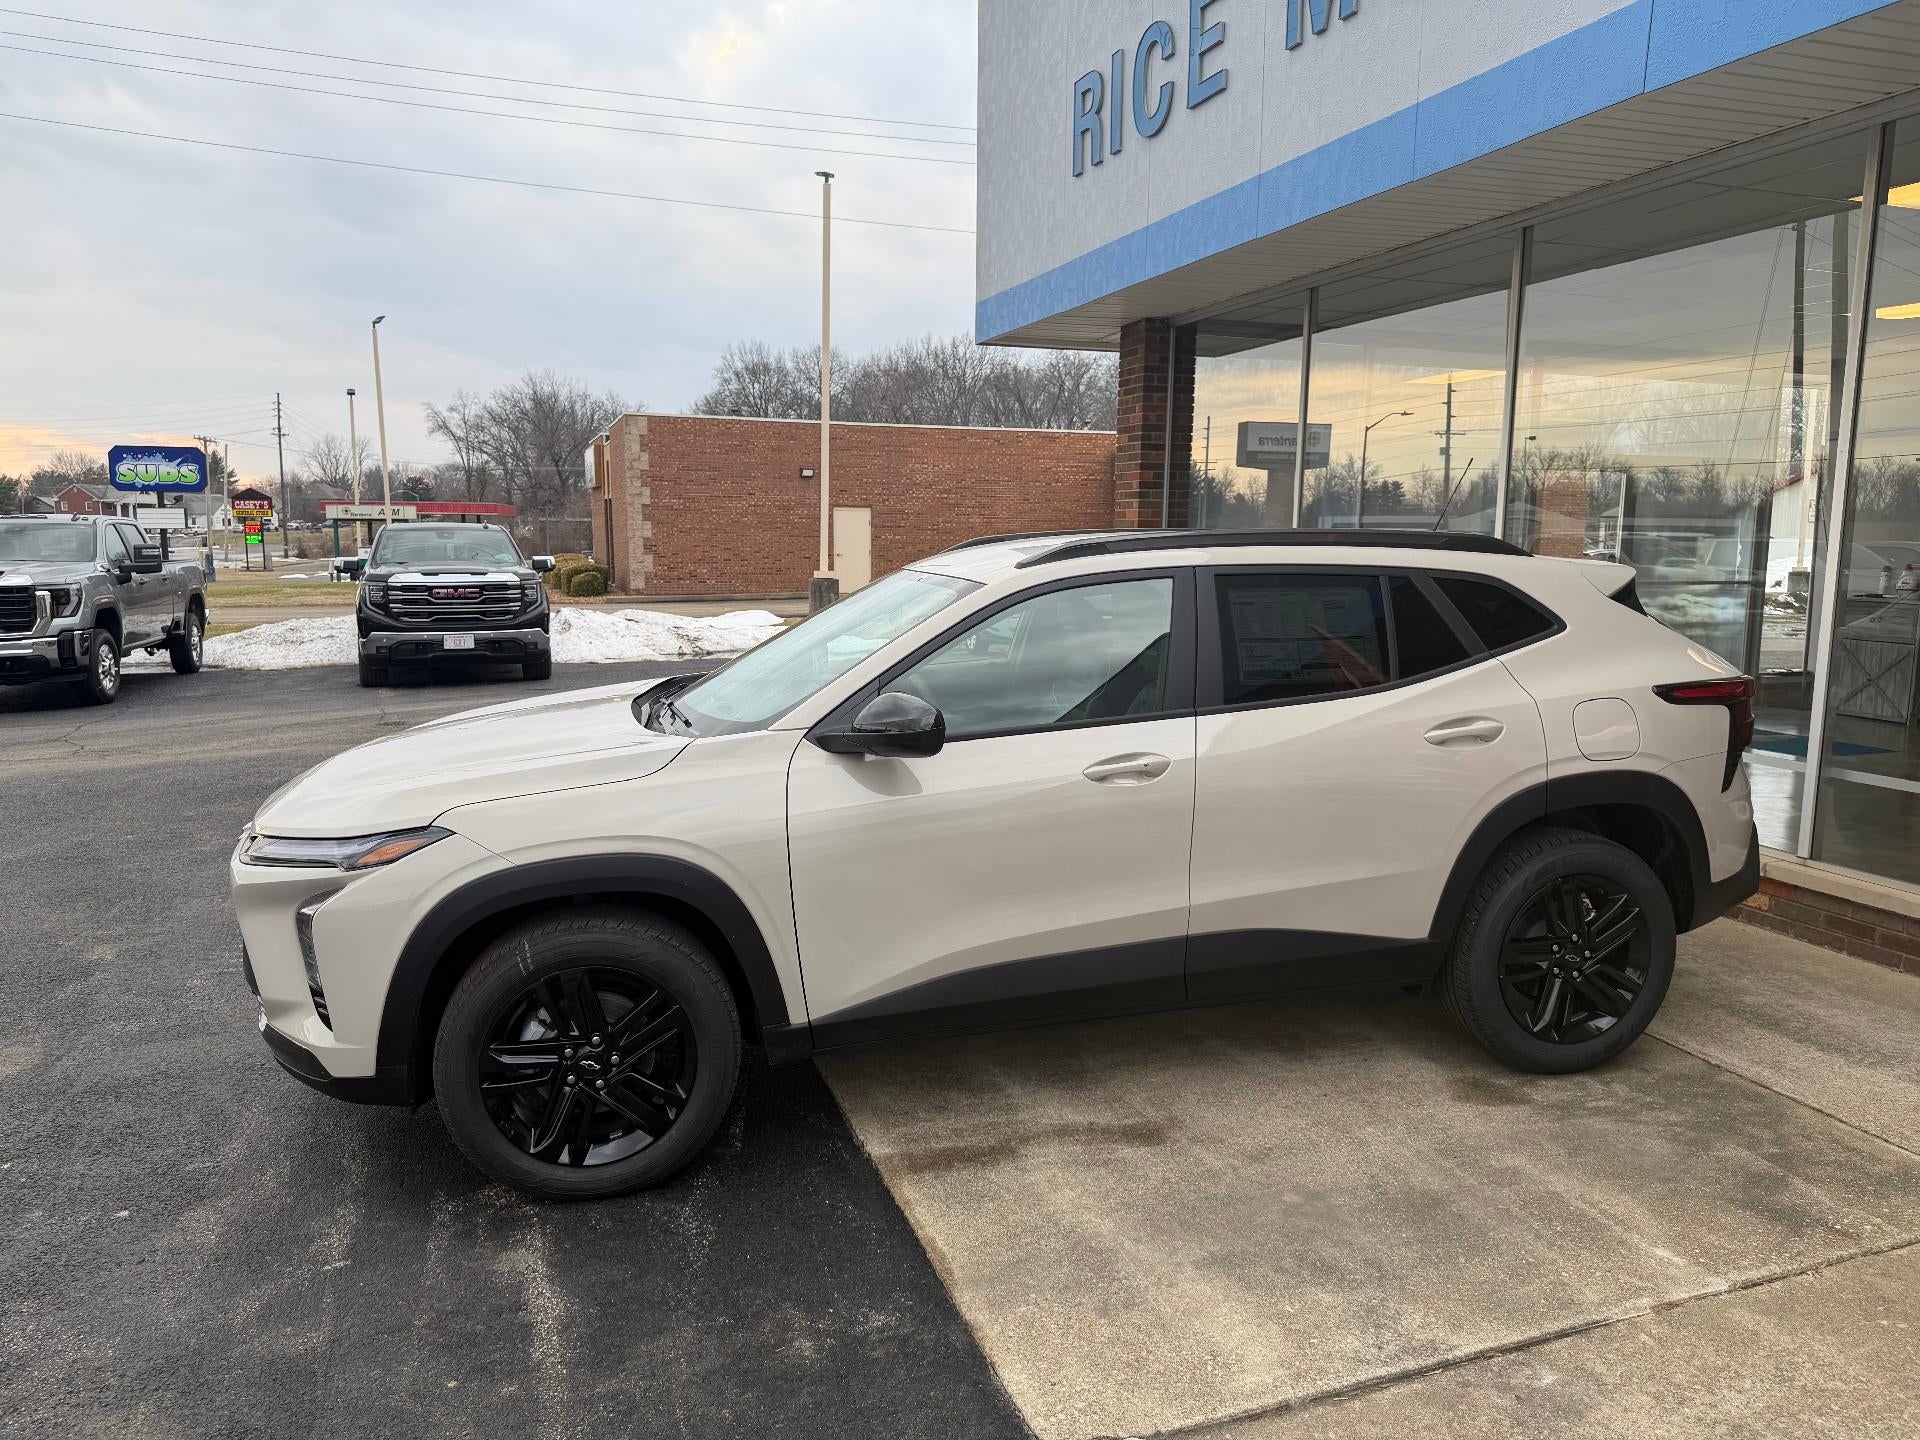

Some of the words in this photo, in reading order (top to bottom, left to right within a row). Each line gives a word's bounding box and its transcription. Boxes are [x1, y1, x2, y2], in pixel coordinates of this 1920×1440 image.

[1072, 0, 1229, 178] RICE
[117, 463, 199, 484] SUDS
[378, 508, 400, 516] AM
[432, 588, 480, 598] GMC
